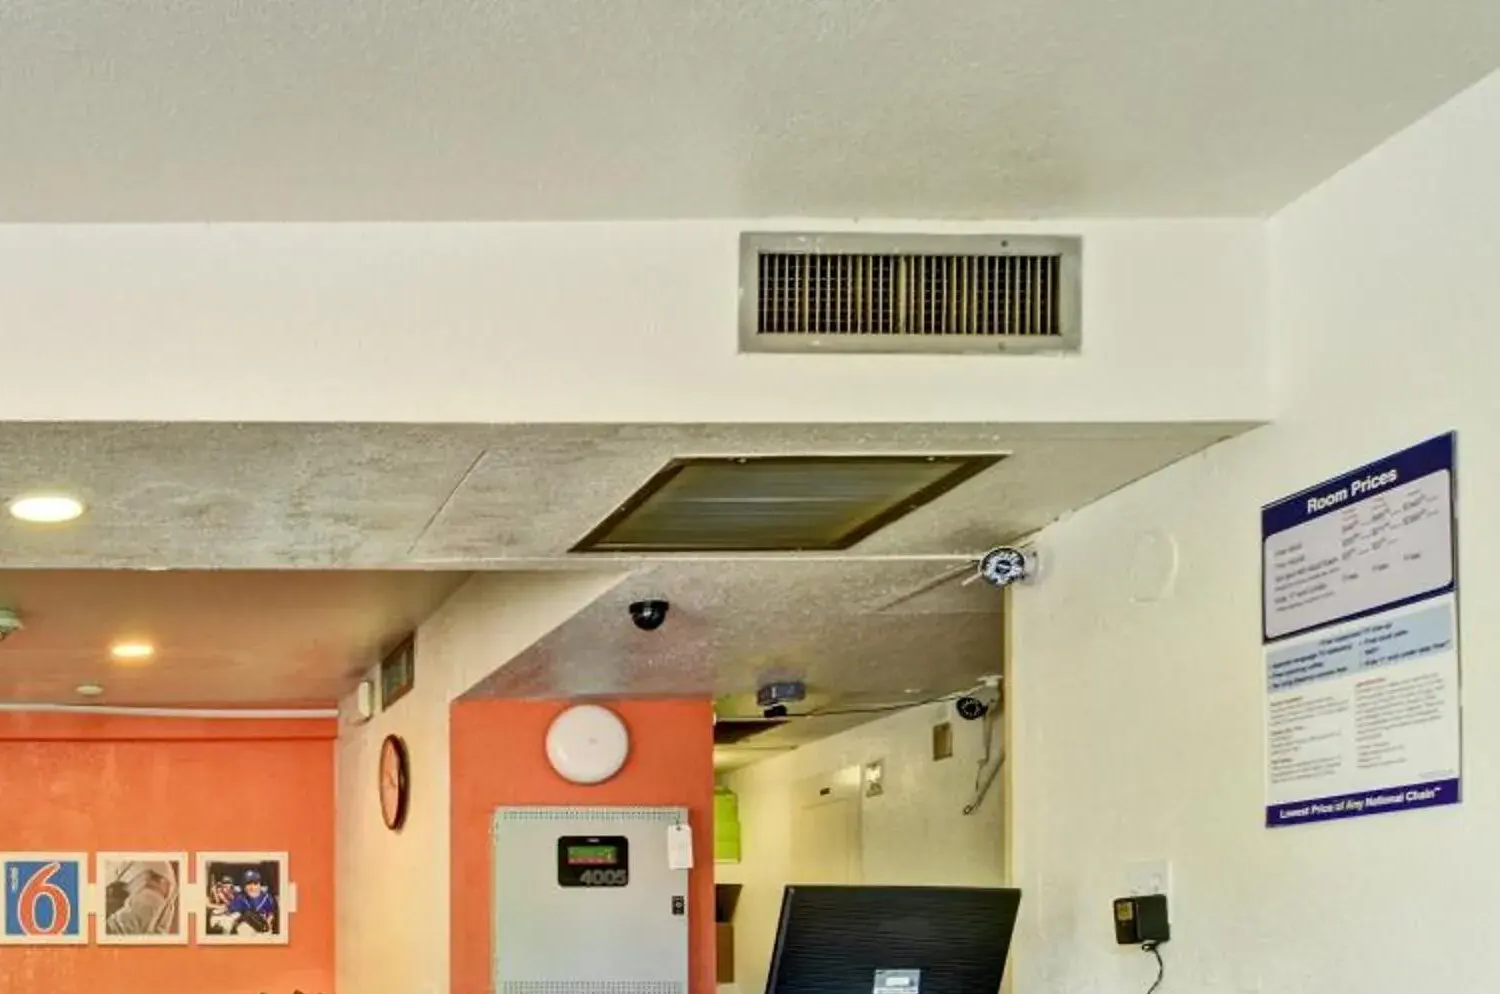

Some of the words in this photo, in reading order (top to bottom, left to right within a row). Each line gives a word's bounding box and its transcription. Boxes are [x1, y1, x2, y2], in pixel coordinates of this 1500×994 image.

[1307, 489, 1348, 514] Room
[1351, 469, 1397, 496] Prices
[1312, 803, 1333, 815] Price
[18, 861, 71, 936] 6
